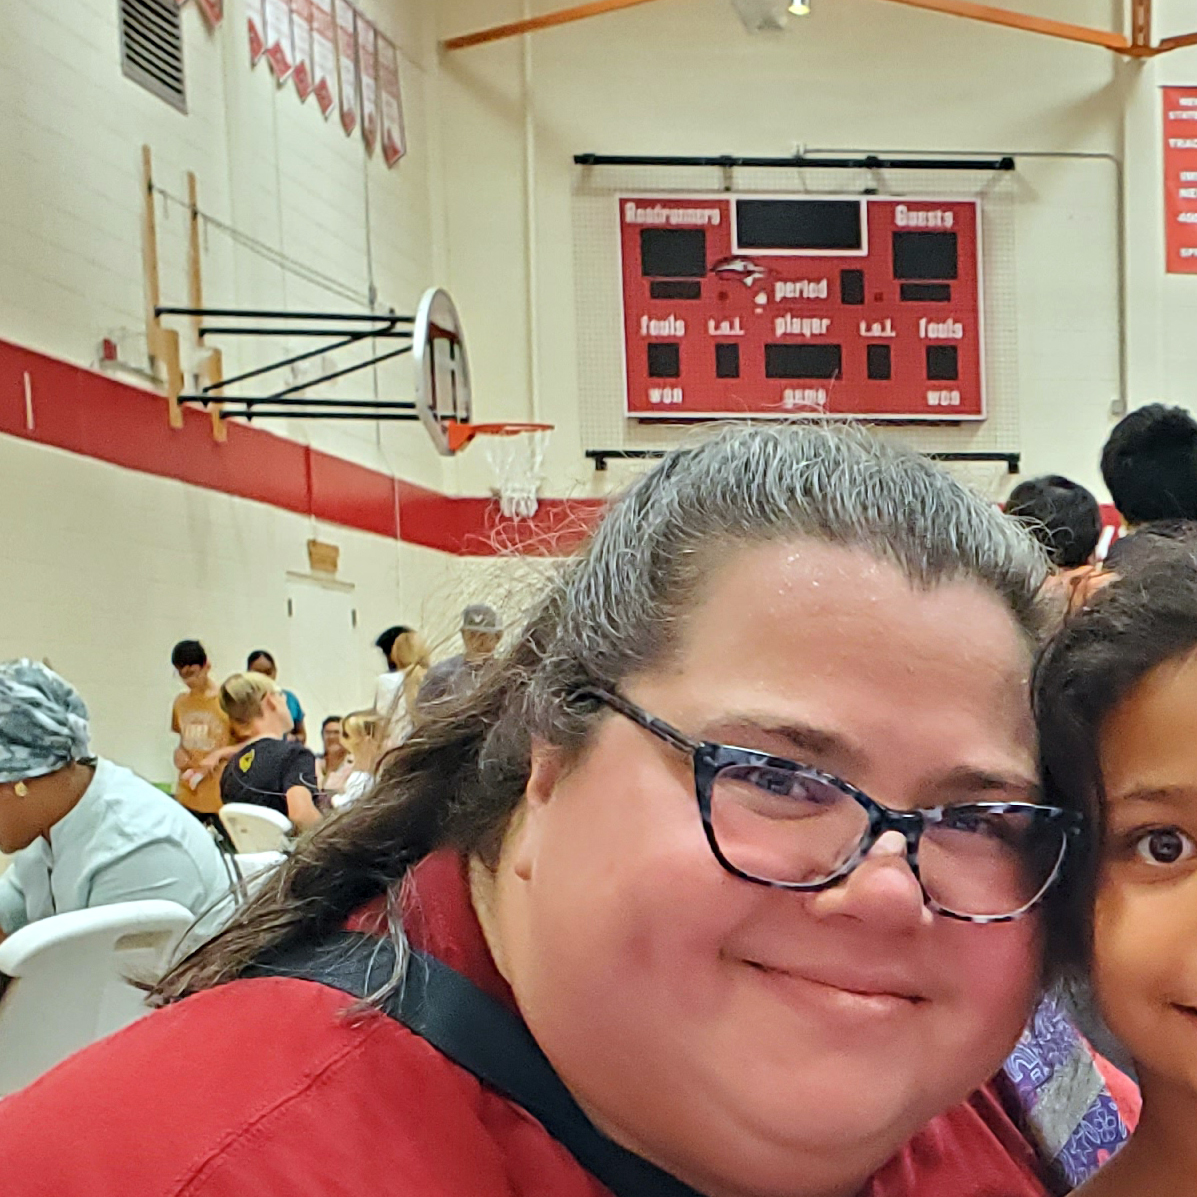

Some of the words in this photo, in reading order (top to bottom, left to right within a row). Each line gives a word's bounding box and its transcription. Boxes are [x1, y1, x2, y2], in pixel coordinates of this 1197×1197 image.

[774, 280, 827, 302] period
[774, 312, 831, 338] player
[648, 387, 683, 404] won
[927, 389, 960, 406] won
